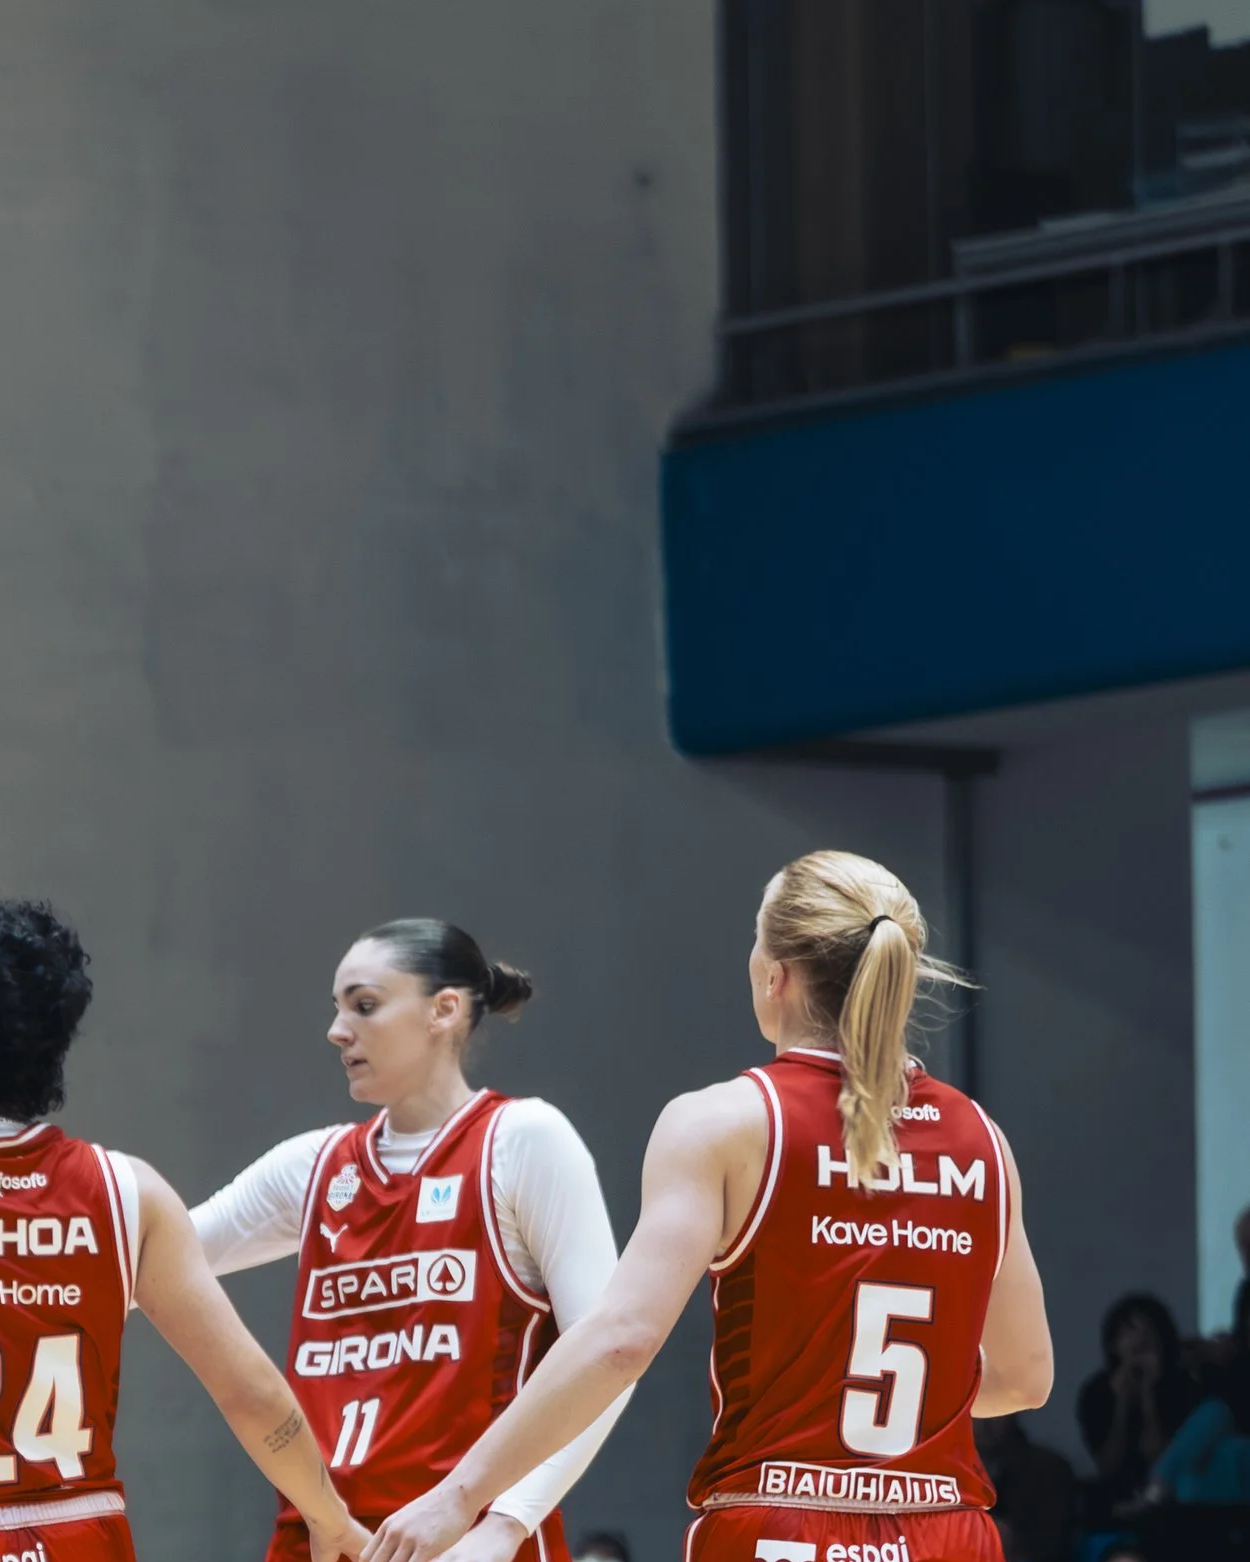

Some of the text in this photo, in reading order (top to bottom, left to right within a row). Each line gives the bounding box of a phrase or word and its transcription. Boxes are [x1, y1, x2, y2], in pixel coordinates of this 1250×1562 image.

[817, 1144, 986, 1201] HOLM
[811, 1215, 973, 1255] Kave Home
[320, 1265, 416, 1308] SPAR
[294, 1324, 461, 1377] GIRONA
[839, 1280, 936, 1459] 5
[330, 1398, 380, 1468] 11
[764, 1468, 960, 1504] BAUHAUS
